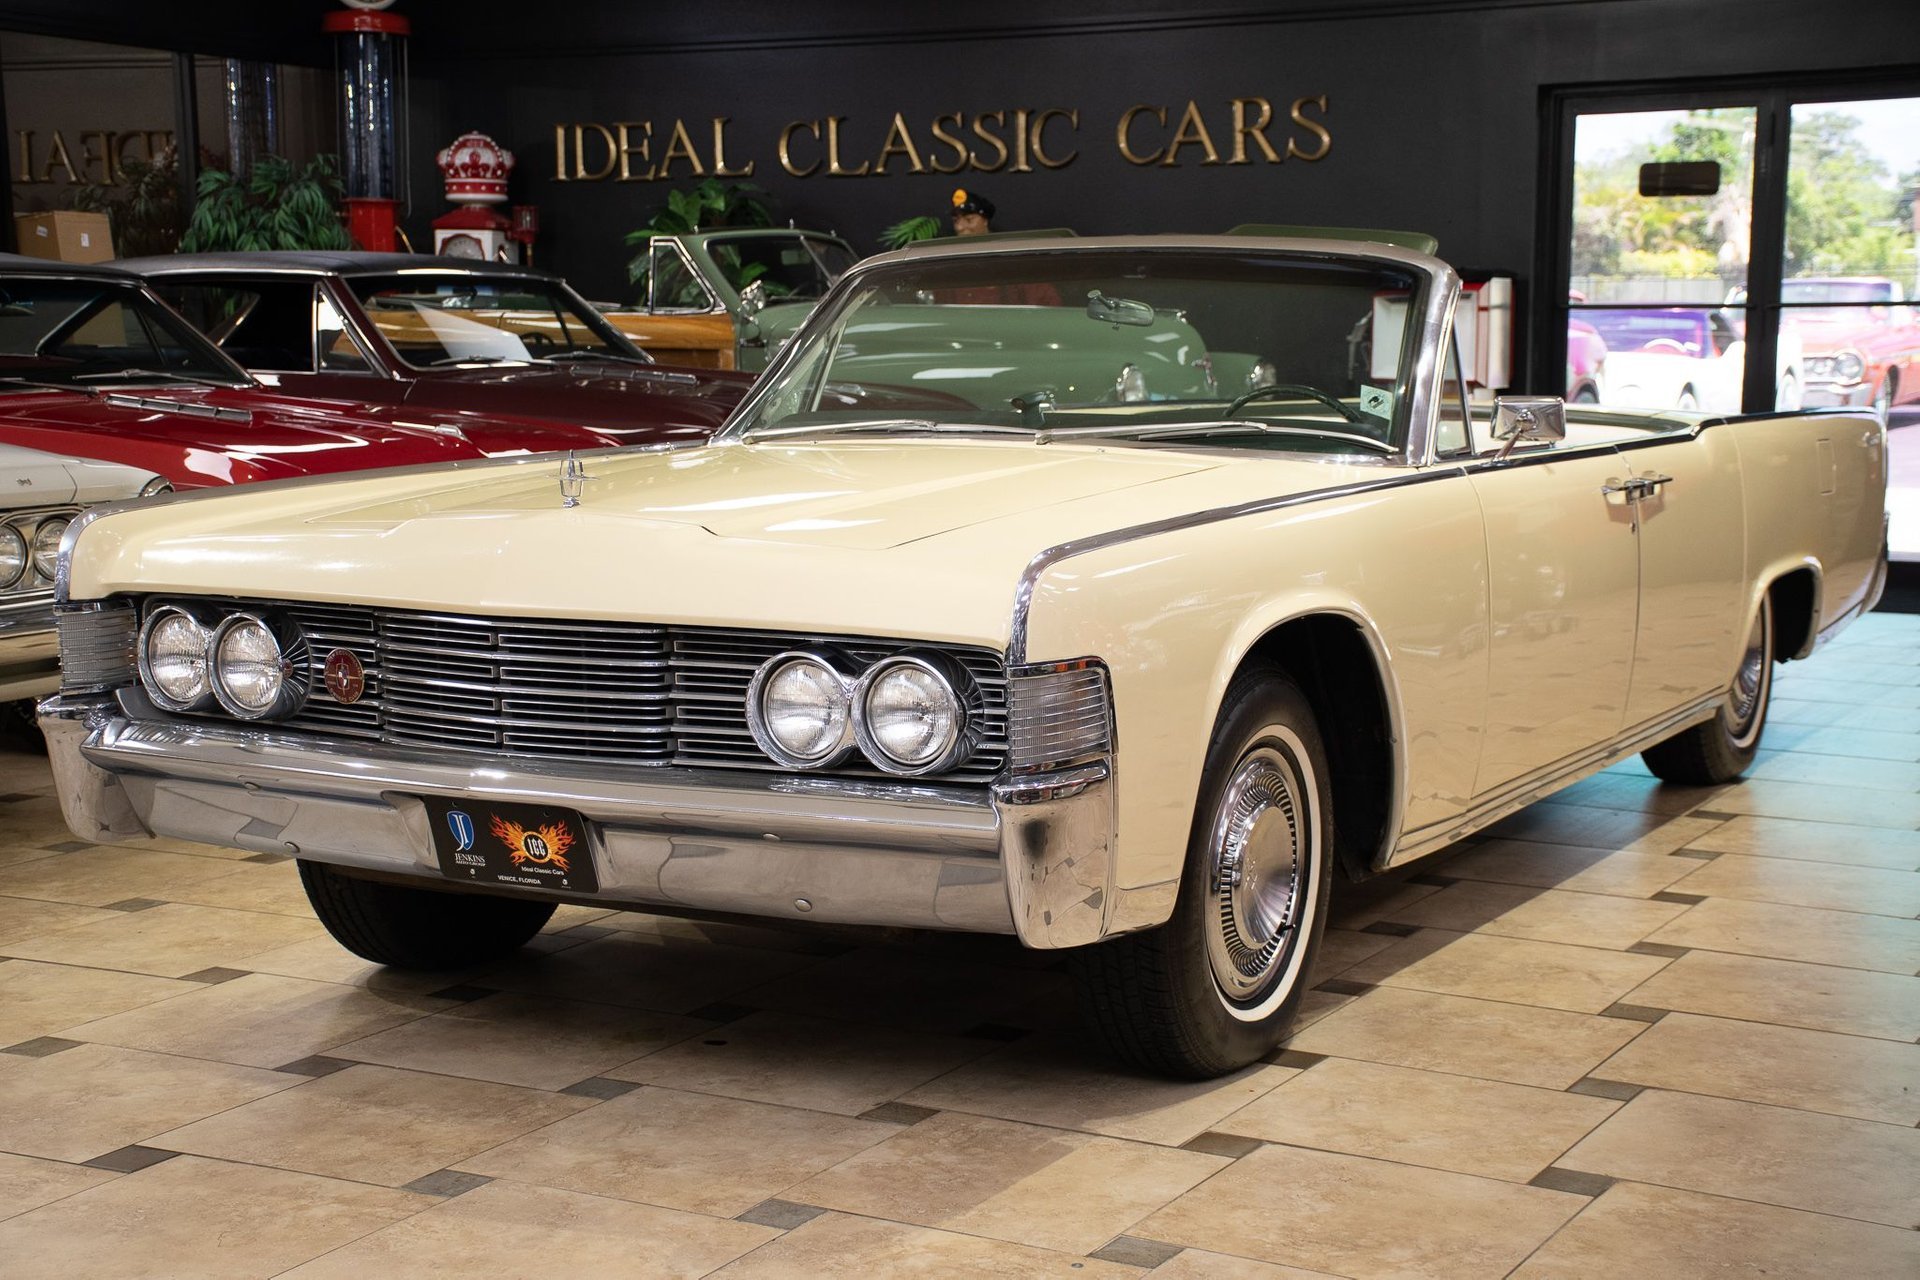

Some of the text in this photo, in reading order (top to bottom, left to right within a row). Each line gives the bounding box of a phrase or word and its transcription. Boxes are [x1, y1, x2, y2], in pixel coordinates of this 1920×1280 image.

[551, 94, 1332, 183] IDEAL CLASSIC CARS
[527, 838, 547, 856] ICC
[455, 853, 485, 862] JENKINS
[534, 866, 552, 875] Classic
